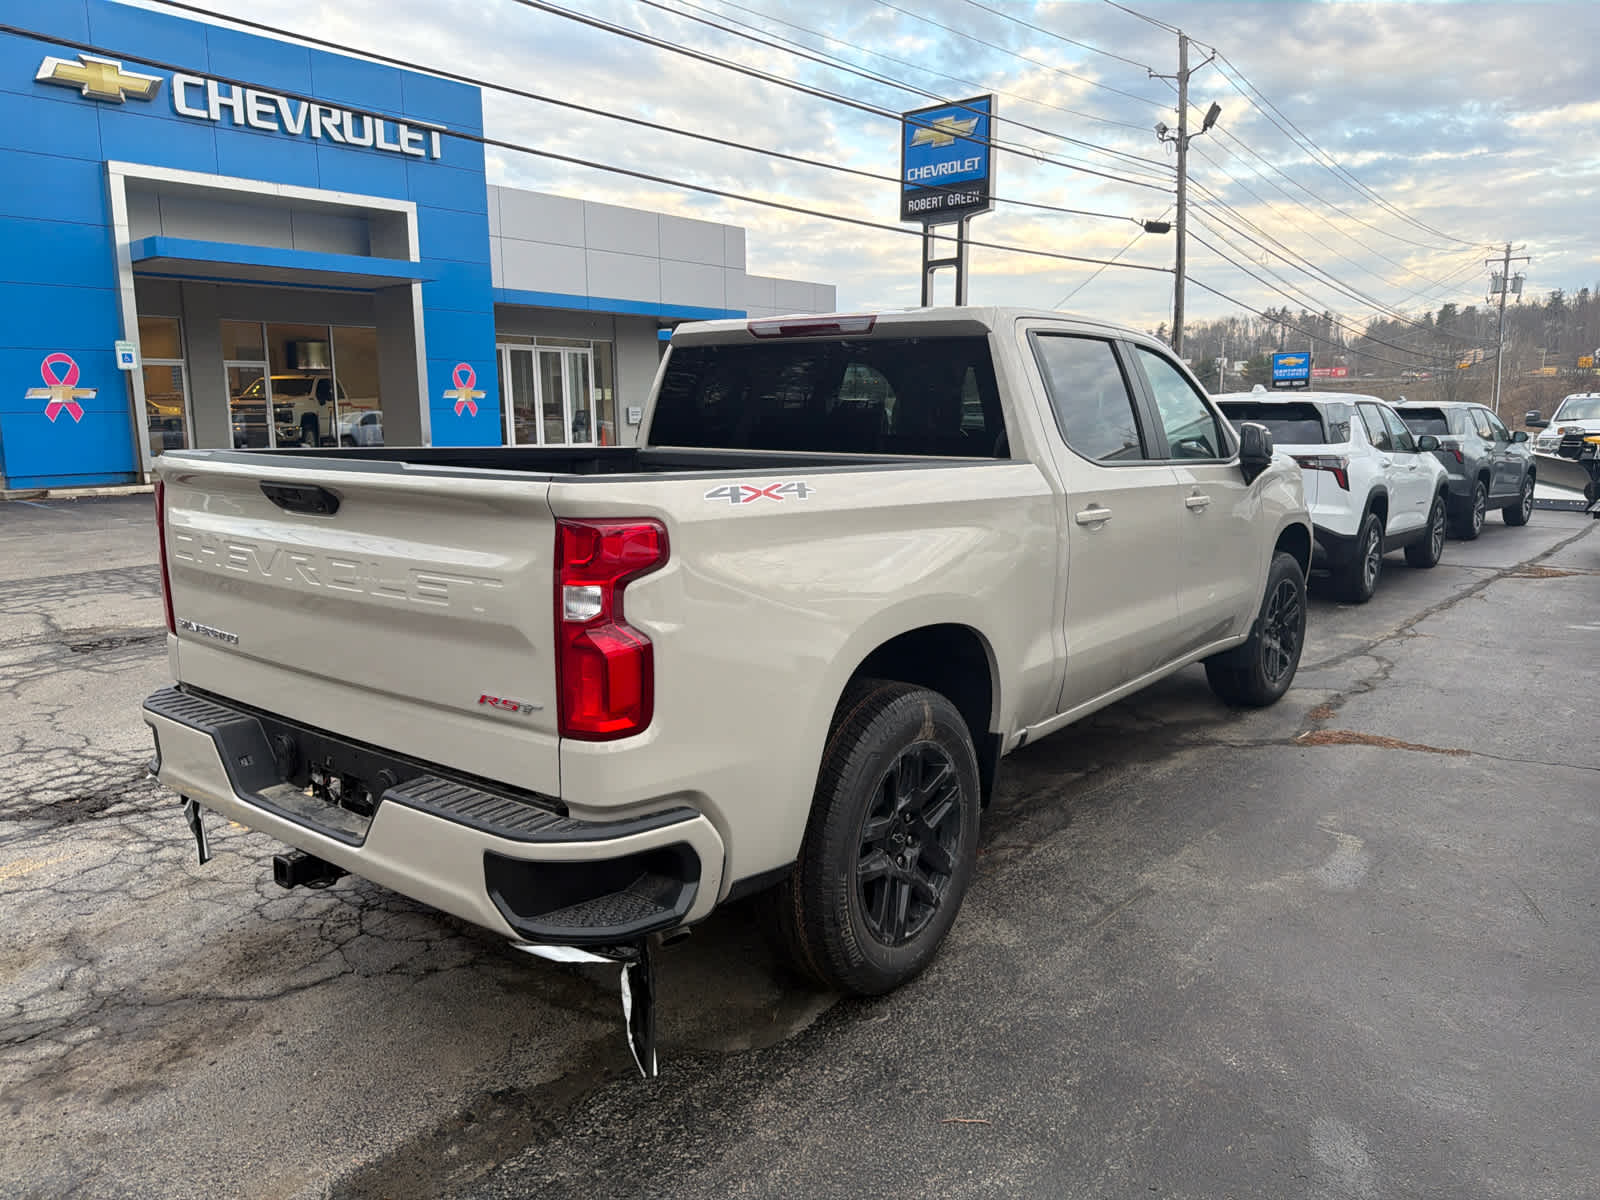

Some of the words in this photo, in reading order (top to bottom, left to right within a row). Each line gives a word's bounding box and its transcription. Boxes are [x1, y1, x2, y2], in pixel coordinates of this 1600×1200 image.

[172, 73, 447, 159] CHEVROLET
[907, 156, 981, 181] CHEVROLET
[908, 195, 943, 212] ROBERT
[947, 190, 981, 206] GREEN
